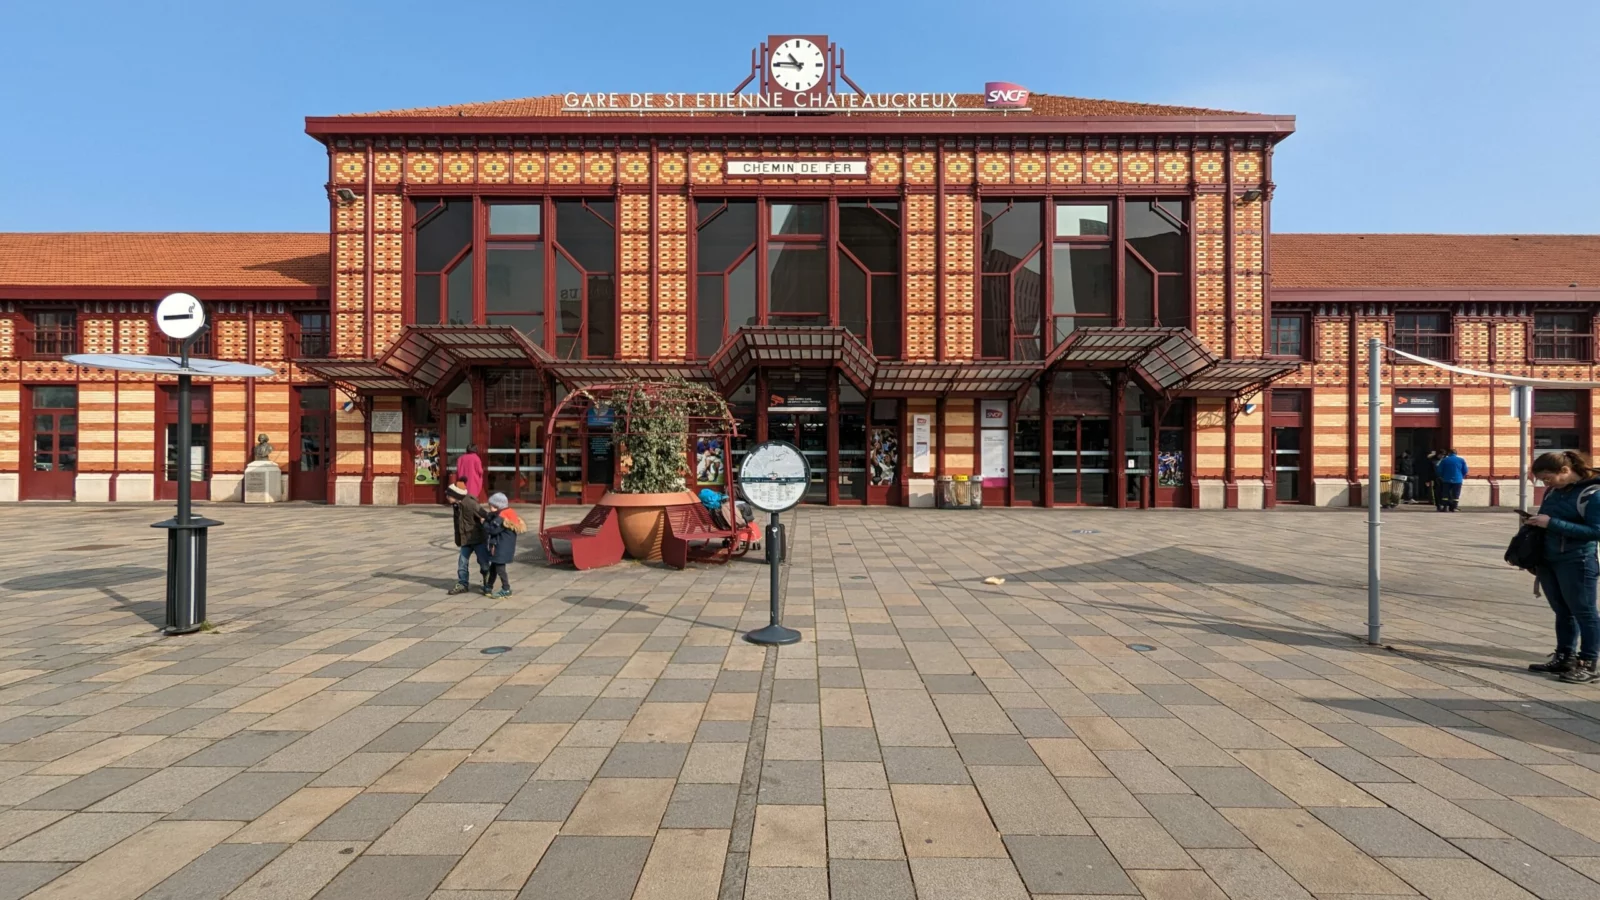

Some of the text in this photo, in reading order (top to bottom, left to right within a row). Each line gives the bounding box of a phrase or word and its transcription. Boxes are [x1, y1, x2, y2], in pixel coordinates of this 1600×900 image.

[564, 92, 958, 108] GARE DE ST ETIENNE CHATEAUCREUX
[987, 90, 1028, 102] SNCF
[743, 163, 852, 173] CHEMIN DE FER
